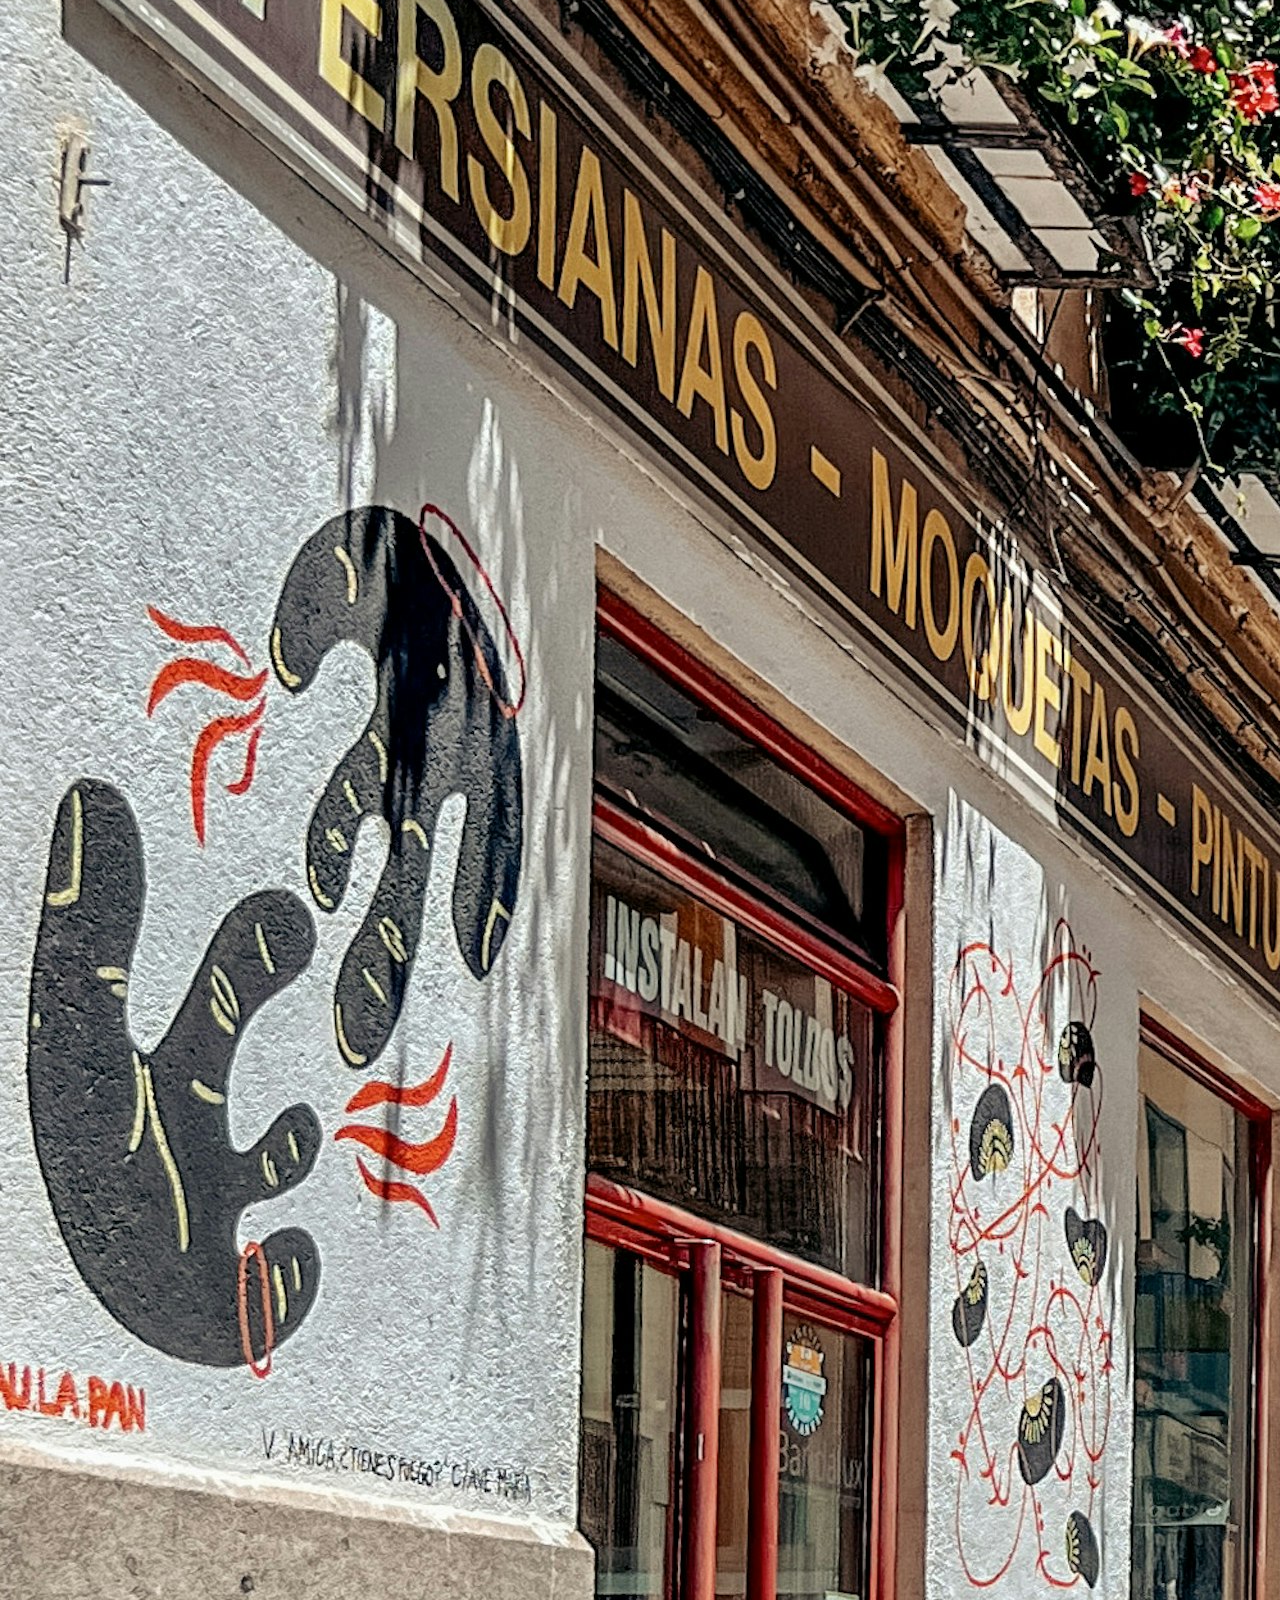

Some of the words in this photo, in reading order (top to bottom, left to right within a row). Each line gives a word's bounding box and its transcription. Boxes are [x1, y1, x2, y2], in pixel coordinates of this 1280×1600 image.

[870, 444, 1141, 839] MOQUETAS
[603, 894, 748, 1053] INSTALAN
[761, 988, 855, 1113] TOLDOS
